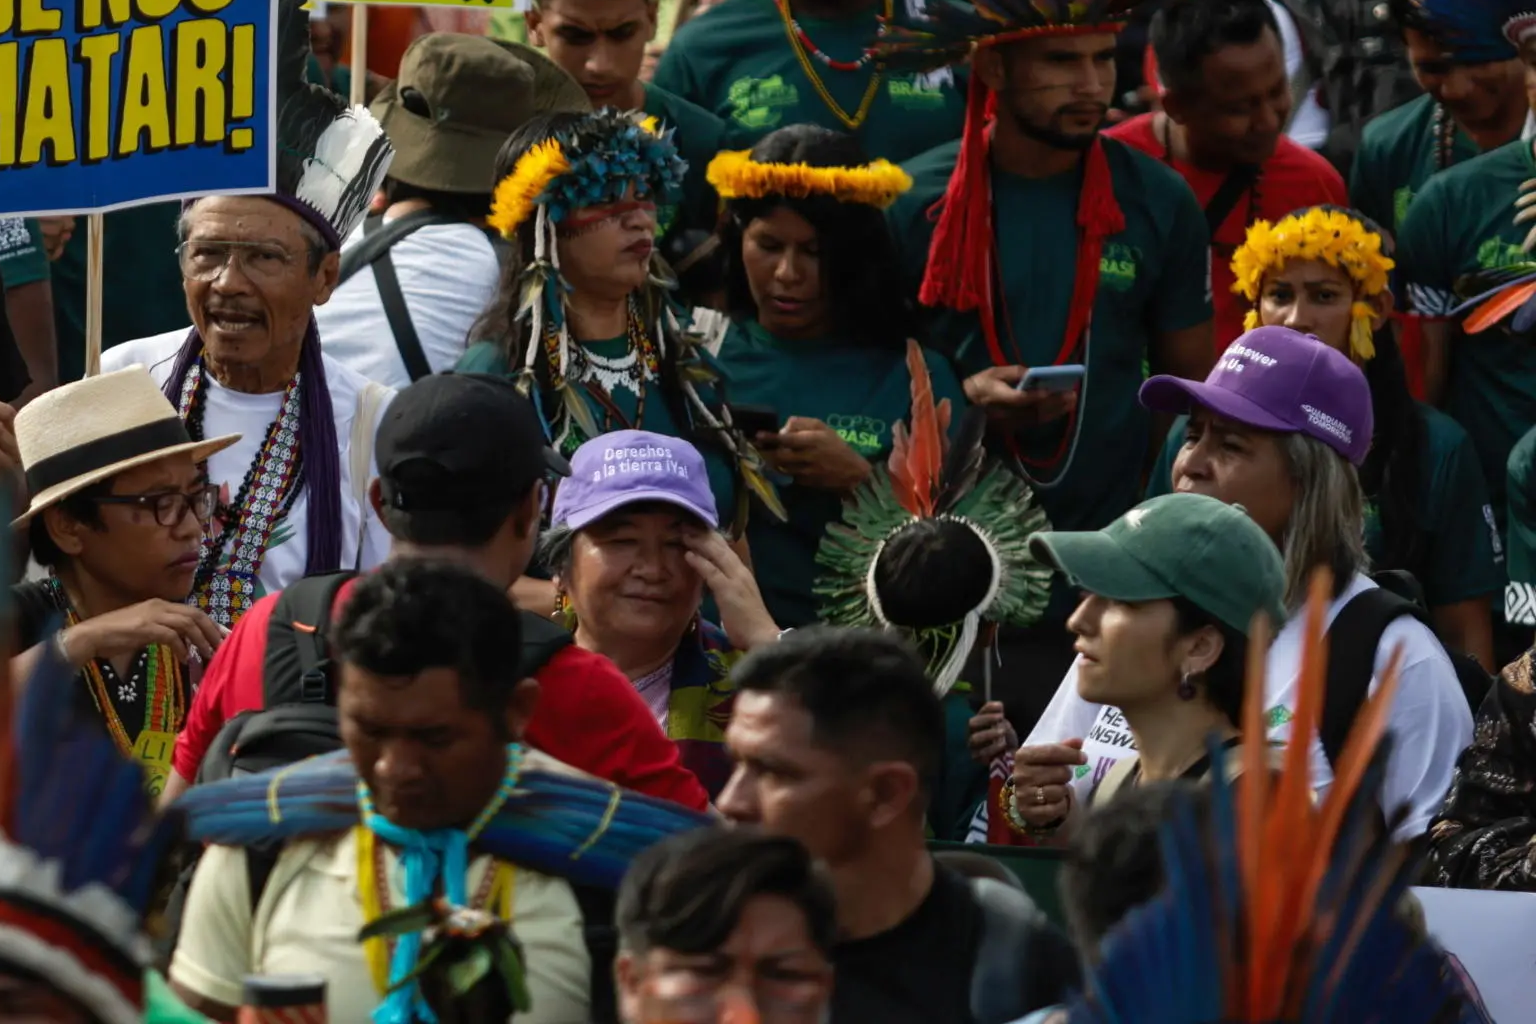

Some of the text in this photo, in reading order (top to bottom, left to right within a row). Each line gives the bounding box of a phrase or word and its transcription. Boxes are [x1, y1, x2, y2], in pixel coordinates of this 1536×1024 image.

[1227, 357, 1245, 373] Us
[836, 428, 883, 449] RASIL
[604, 443, 673, 462] Derechos
[592, 470, 602, 483] a
[603, 463, 616, 479] la
[619, 458, 663, 472] tierra
